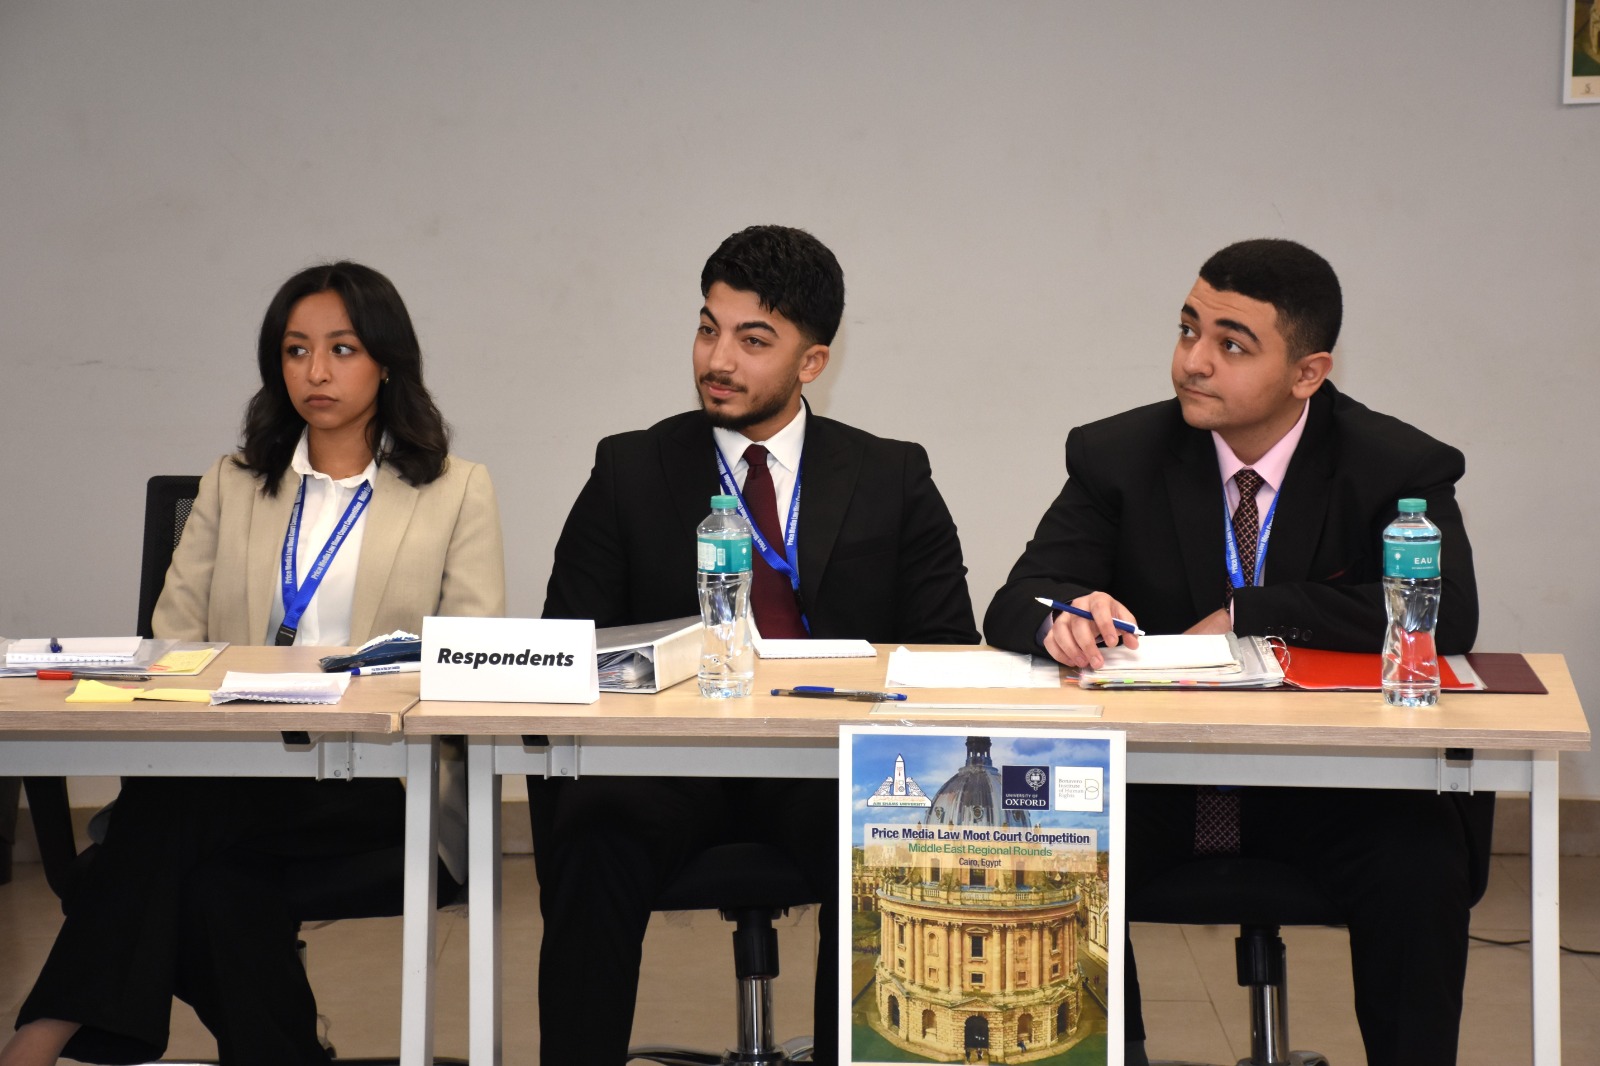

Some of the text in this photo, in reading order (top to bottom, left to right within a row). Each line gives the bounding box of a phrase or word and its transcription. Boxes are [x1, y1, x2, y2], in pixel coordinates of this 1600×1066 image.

[757, 537, 768, 552] Price
[787, 533, 795, 545] Price
[284, 555, 293, 571] Media
[311, 566, 324, 580] Price
[318, 553, 331, 568] Media
[326, 545, 337, 555] Law
[1414, 557, 1433, 565] EAU
[284, 570, 293, 584] Price
[437, 648, 575, 669] Respondents
[1005, 798, 1046, 807] OXFORD
[871, 827, 1090, 845] Price Media Law Moot Court Competition
[908, 843, 1053, 857] Middle East Regional Rounds
[958, 857, 1002, 868] Cairo, Egypt
